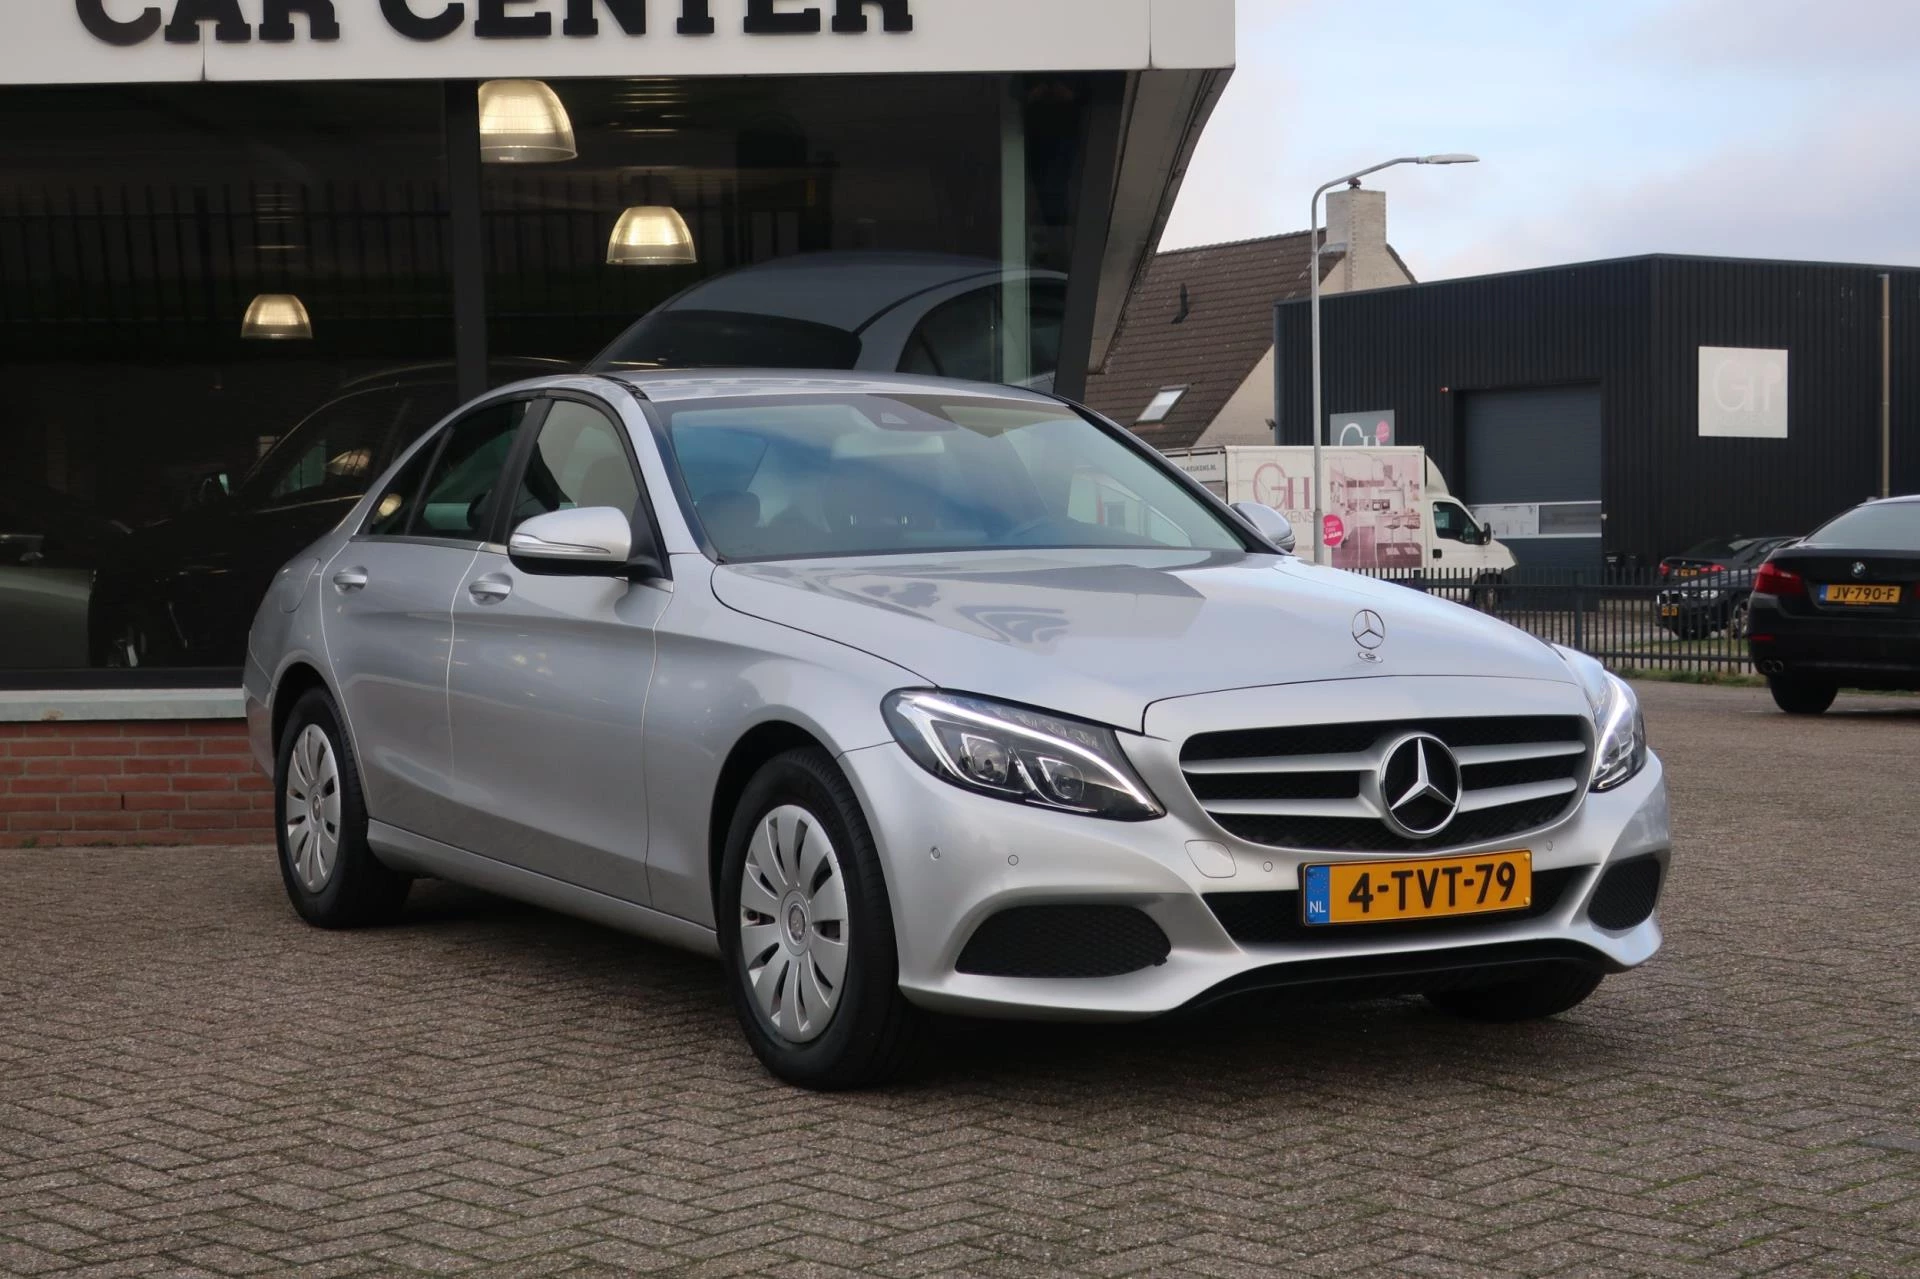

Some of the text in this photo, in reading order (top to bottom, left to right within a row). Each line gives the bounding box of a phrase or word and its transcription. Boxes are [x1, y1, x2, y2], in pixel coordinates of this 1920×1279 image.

[1832, 586, 1896, 601] JV-790-F
[1309, 861, 1517, 914] NL 4-TVT-79
